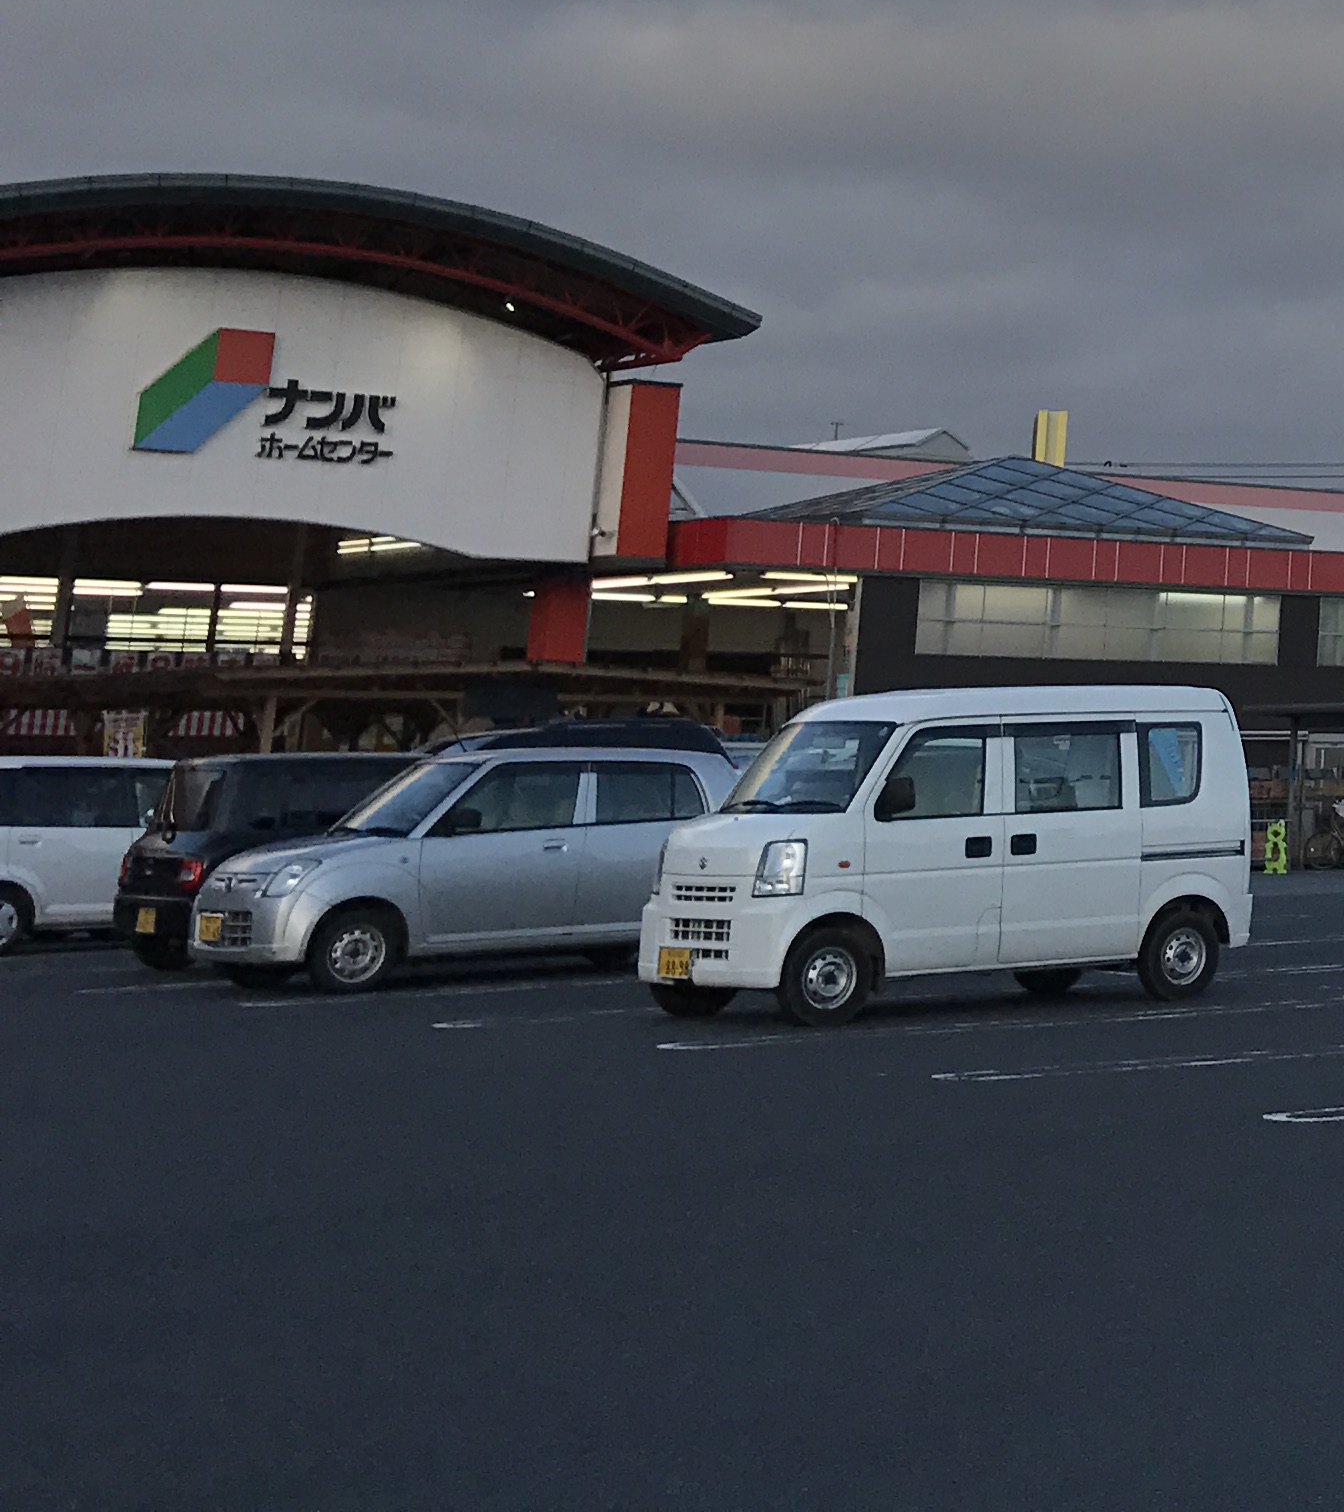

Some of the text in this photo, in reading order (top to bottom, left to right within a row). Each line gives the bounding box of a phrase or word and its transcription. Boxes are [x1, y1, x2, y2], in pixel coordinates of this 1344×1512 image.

[263, 379, 397, 434] ナンバ
[256, 432, 394, 465] ホームセンター
